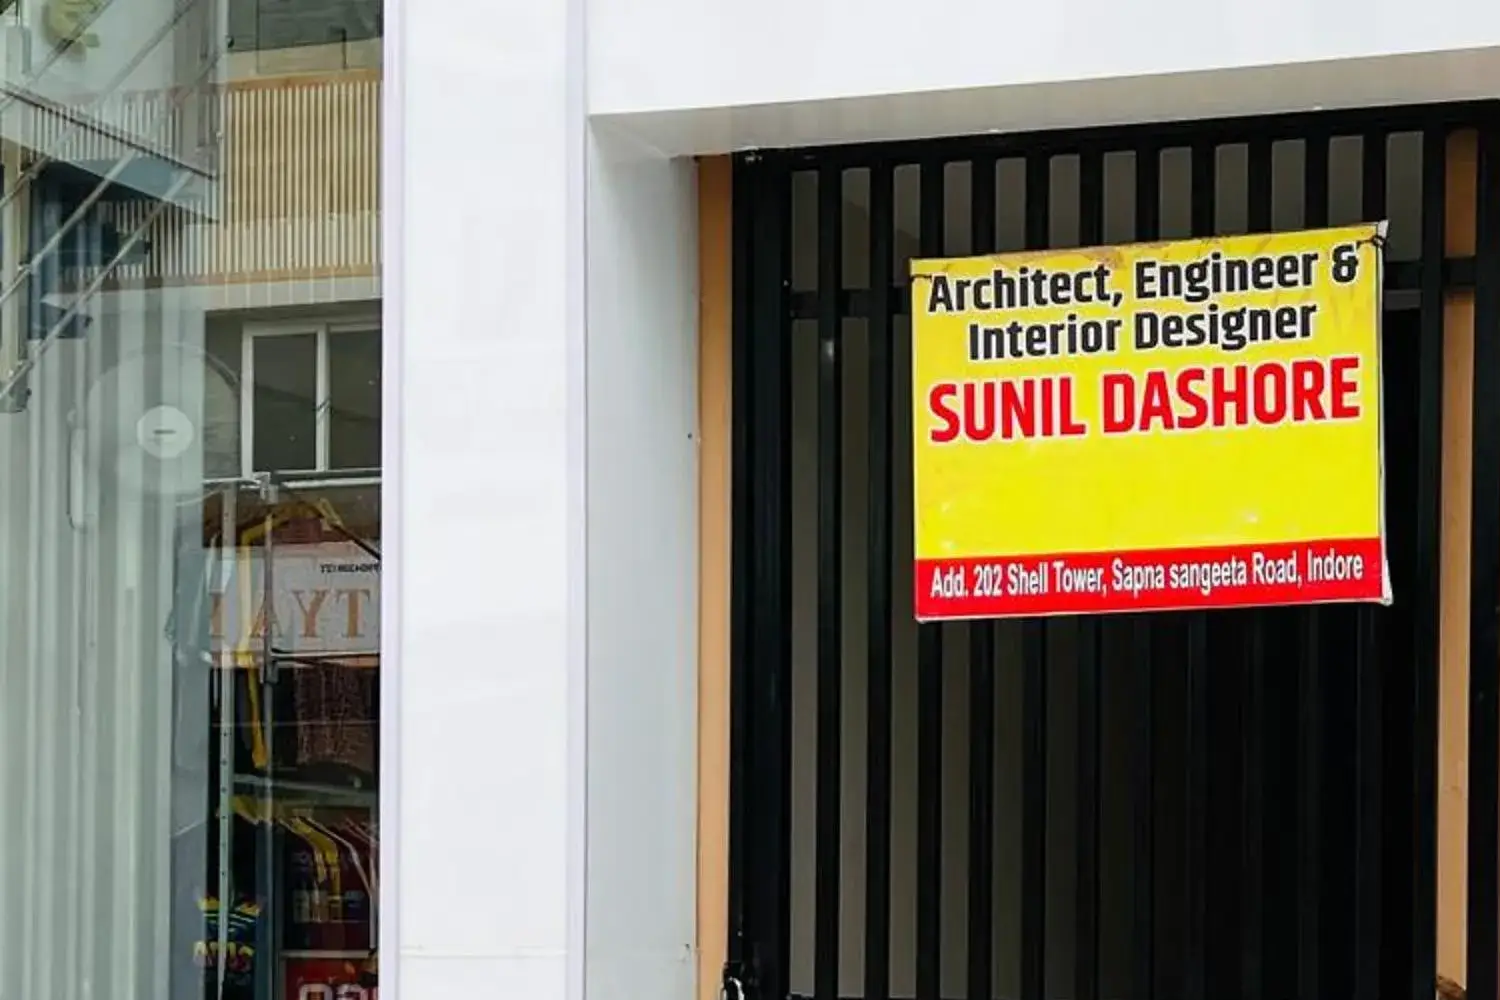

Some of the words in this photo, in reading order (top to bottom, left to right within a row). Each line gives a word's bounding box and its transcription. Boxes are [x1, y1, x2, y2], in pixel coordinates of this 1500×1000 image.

[928, 264, 1124, 313] Architect,
[1135, 251, 1319, 303] Engineer
[1331, 244, 1359, 283] &
[969, 314, 1122, 361] Interior
[1135, 303, 1318, 351] Designer
[929, 377, 1087, 443] SUNIL
[1103, 356, 1361, 434] DASHORE
[930, 564, 969, 598] Add.
[973, 563, 1003, 597] 202
[1007, 561, 1049, 595] Shell
[1053, 560, 1107, 597] Tower,
[1111, 557, 1166, 598] Sapna
[1169, 556, 1247, 597] sangeeta
[1251, 550, 1302, 588] Road,
[1307, 547, 1363, 583] Indore
